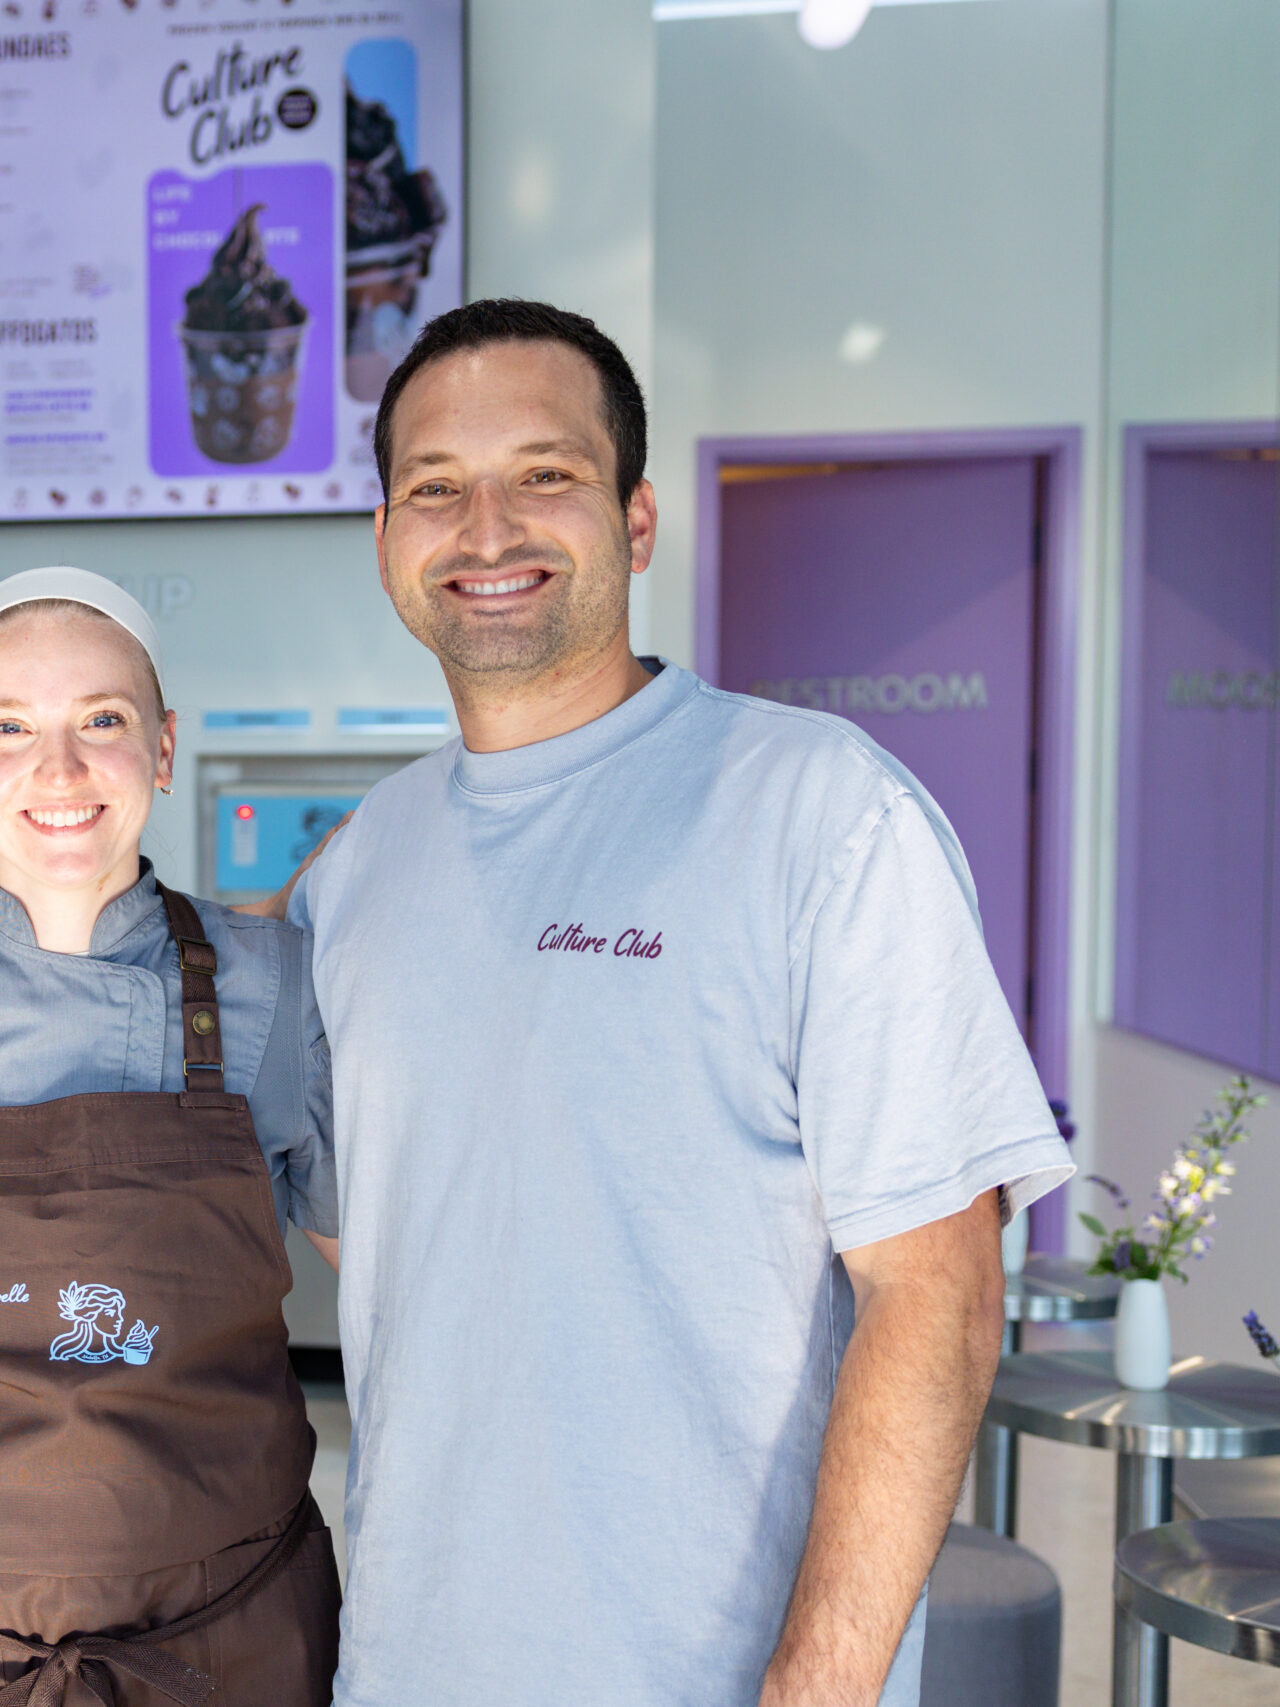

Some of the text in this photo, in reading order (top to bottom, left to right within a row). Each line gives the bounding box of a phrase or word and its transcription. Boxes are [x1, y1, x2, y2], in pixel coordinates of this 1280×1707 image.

[162, 42, 304, 119] Culture
[190, 96, 273, 165] Club
[537, 923, 662, 959] Culture Club
